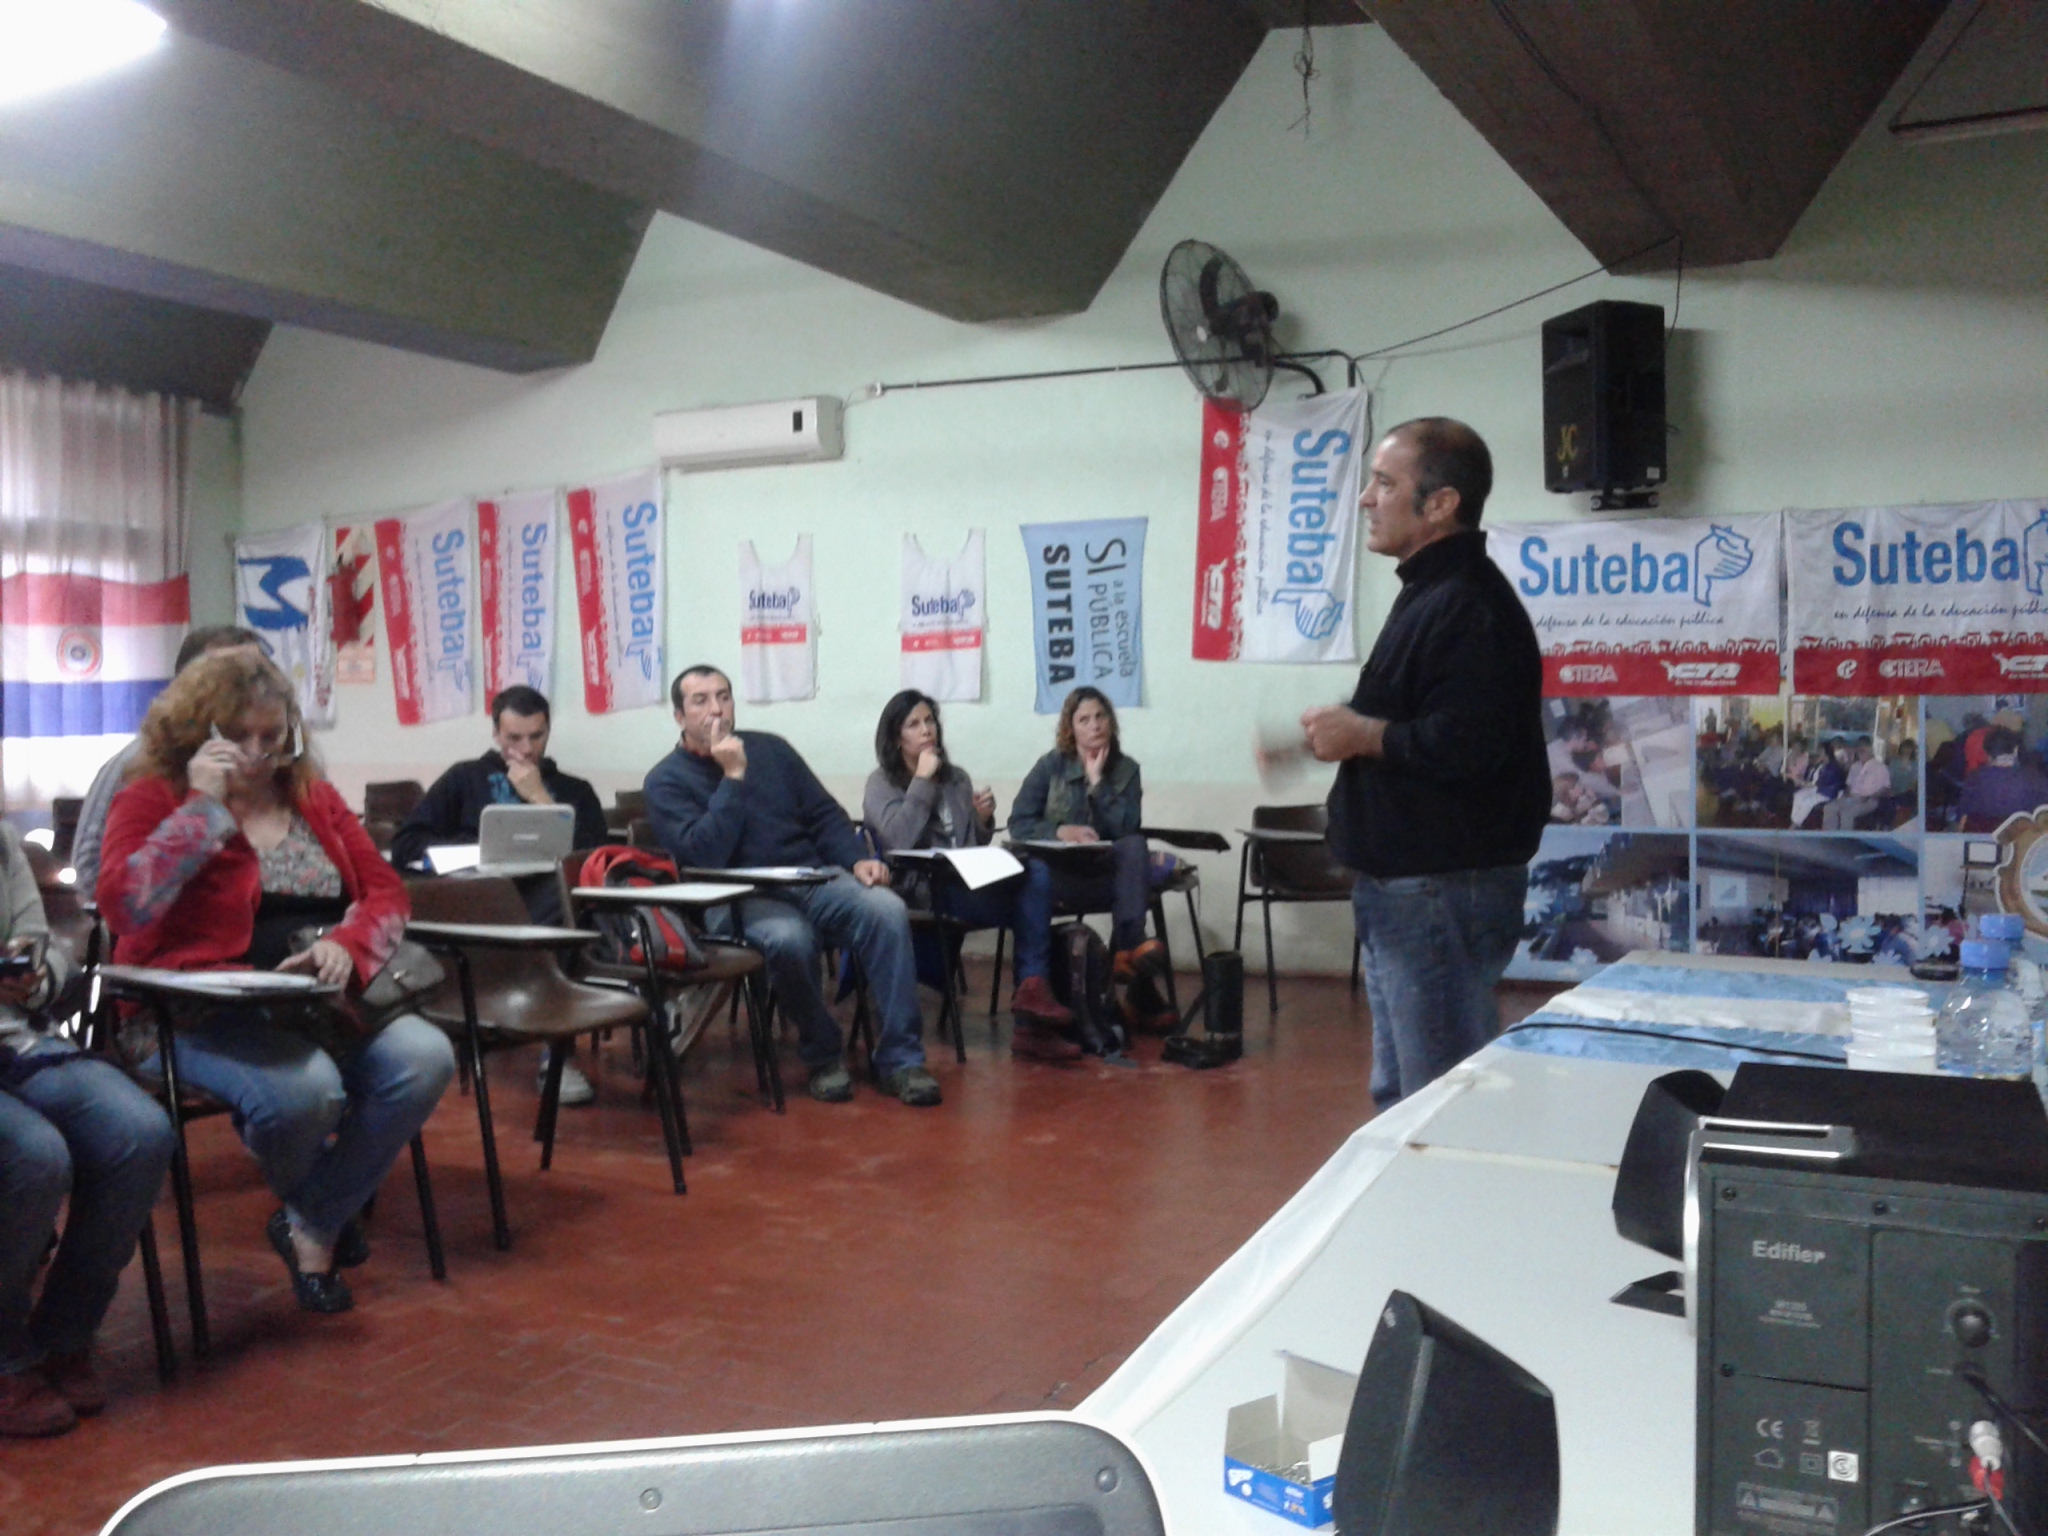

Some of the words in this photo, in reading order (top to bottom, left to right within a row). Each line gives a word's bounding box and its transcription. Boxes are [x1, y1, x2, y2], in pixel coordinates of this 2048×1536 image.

[1286, 428, 1351, 585] Suteba
[622, 501, 658, 638] Suteba
[1084, 537, 1128, 576] SI
[1519, 535, 1690, 597] Suteba
[1832, 521, 2020, 587] Suteba
[432, 528, 466, 654] Suteba
[521, 522, 548, 650] Suteba
[911, 594, 958, 616] Suteba
[1043, 543, 1076, 686] SUTEBA
[1536, 615, 1578, 632] defensa
[1581, 613, 1595, 627] de
[1599, 612, 1611, 626] la
[1615, 613, 1677, 627] educación
[1679, 611, 1725, 630] pública
[1853, 605, 1898, 624] defensa
[1903, 605, 1917, 619] de
[1921, 603, 1936, 617] la
[1941, 603, 2008, 617] educación
[1115, 609, 1138, 678] escuela
[1878, 658, 1946, 679] CTERA
[1559, 664, 1619, 684] CTERA
[1674, 662, 1742, 679] CTA
[1752, 1239, 1826, 1264] Edifier
